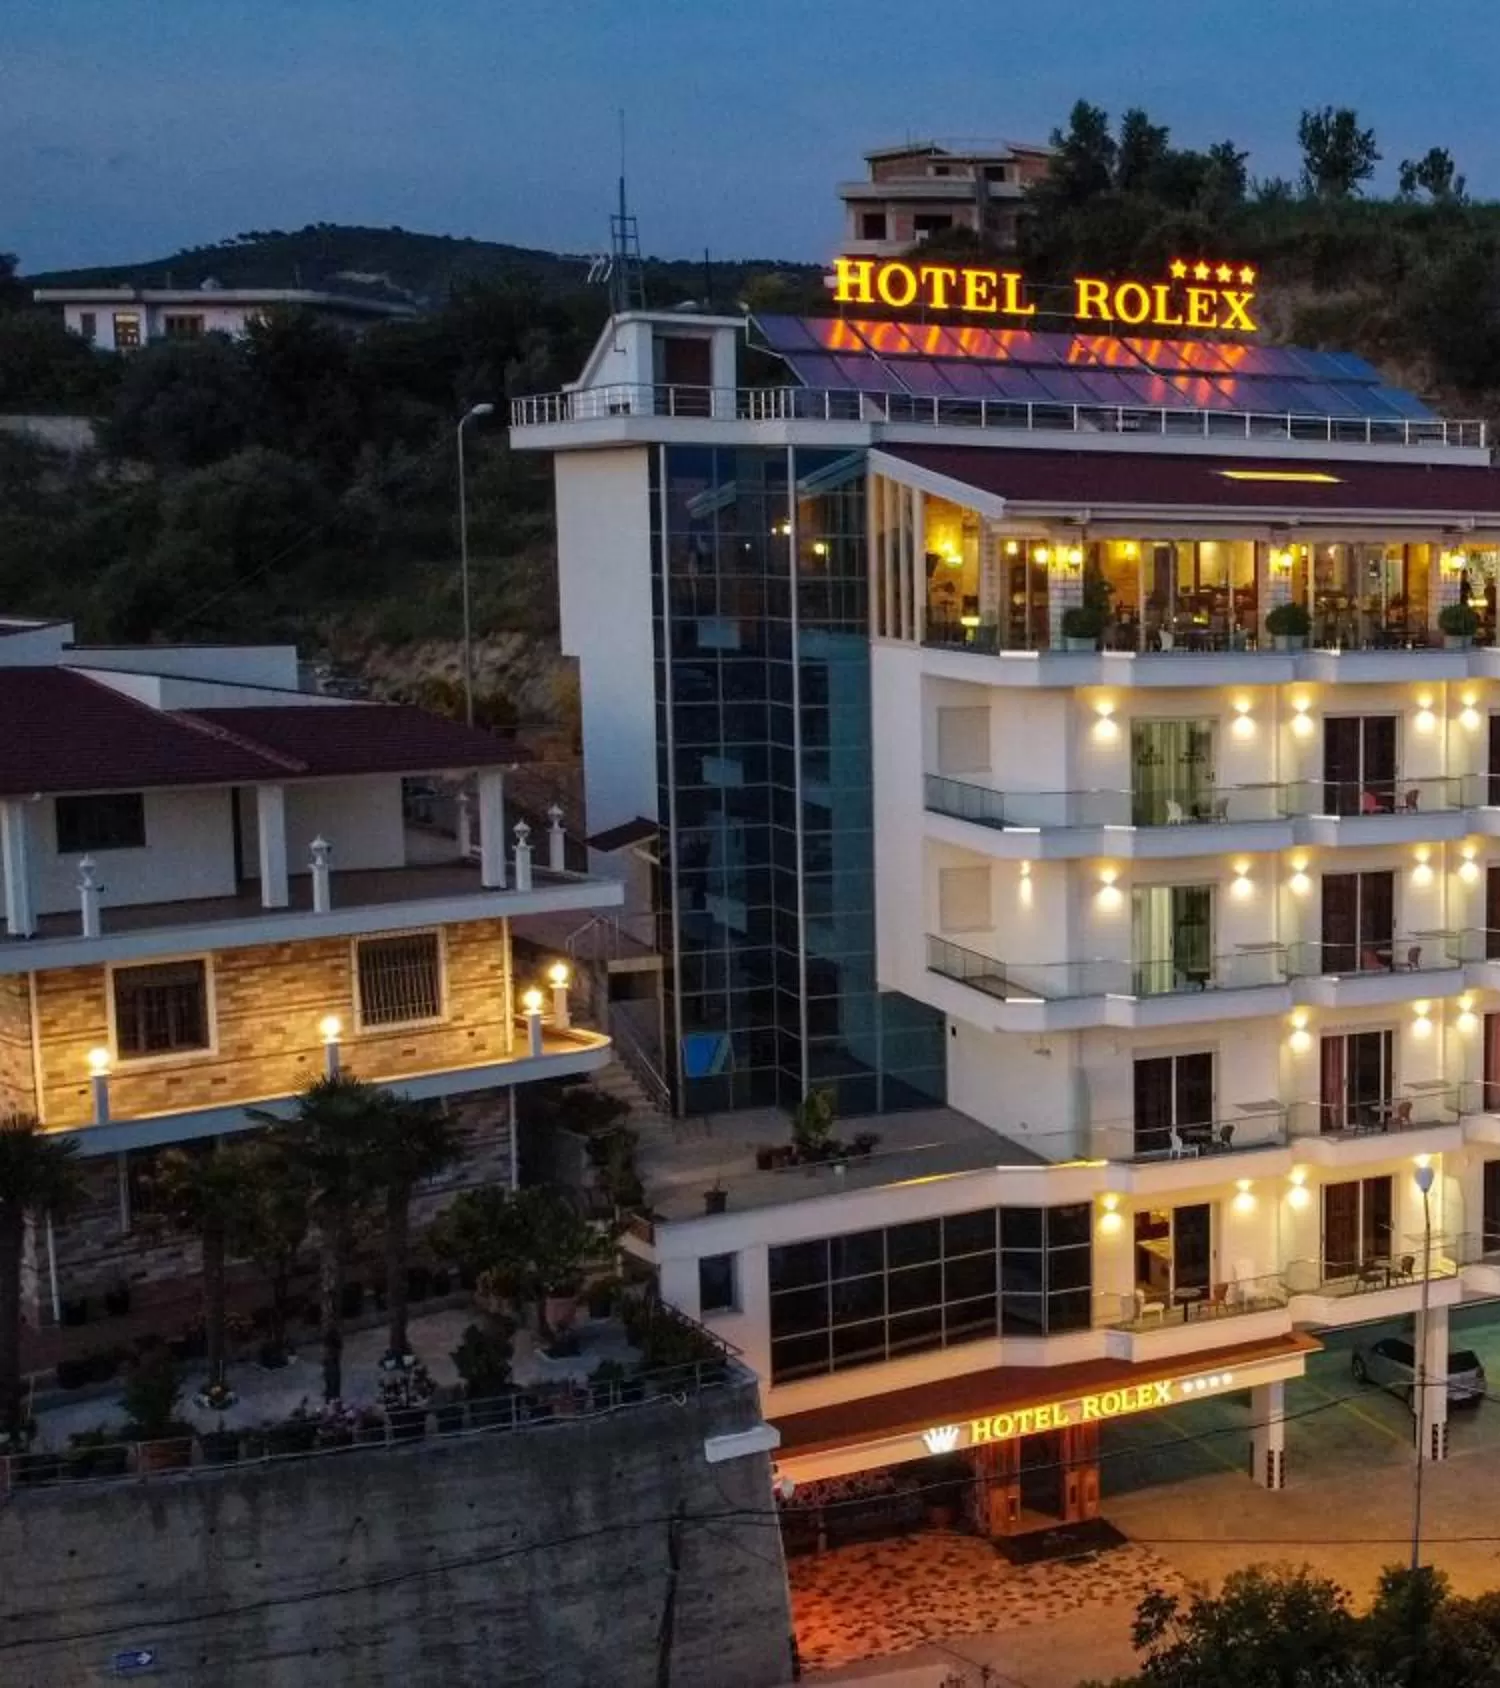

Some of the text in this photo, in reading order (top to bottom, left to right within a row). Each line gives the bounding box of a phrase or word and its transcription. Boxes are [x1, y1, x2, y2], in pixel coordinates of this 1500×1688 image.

[833, 258, 1258, 332] HOTEL ROLEX
[970, 1379, 1174, 1444] HOTEL ROLEX
